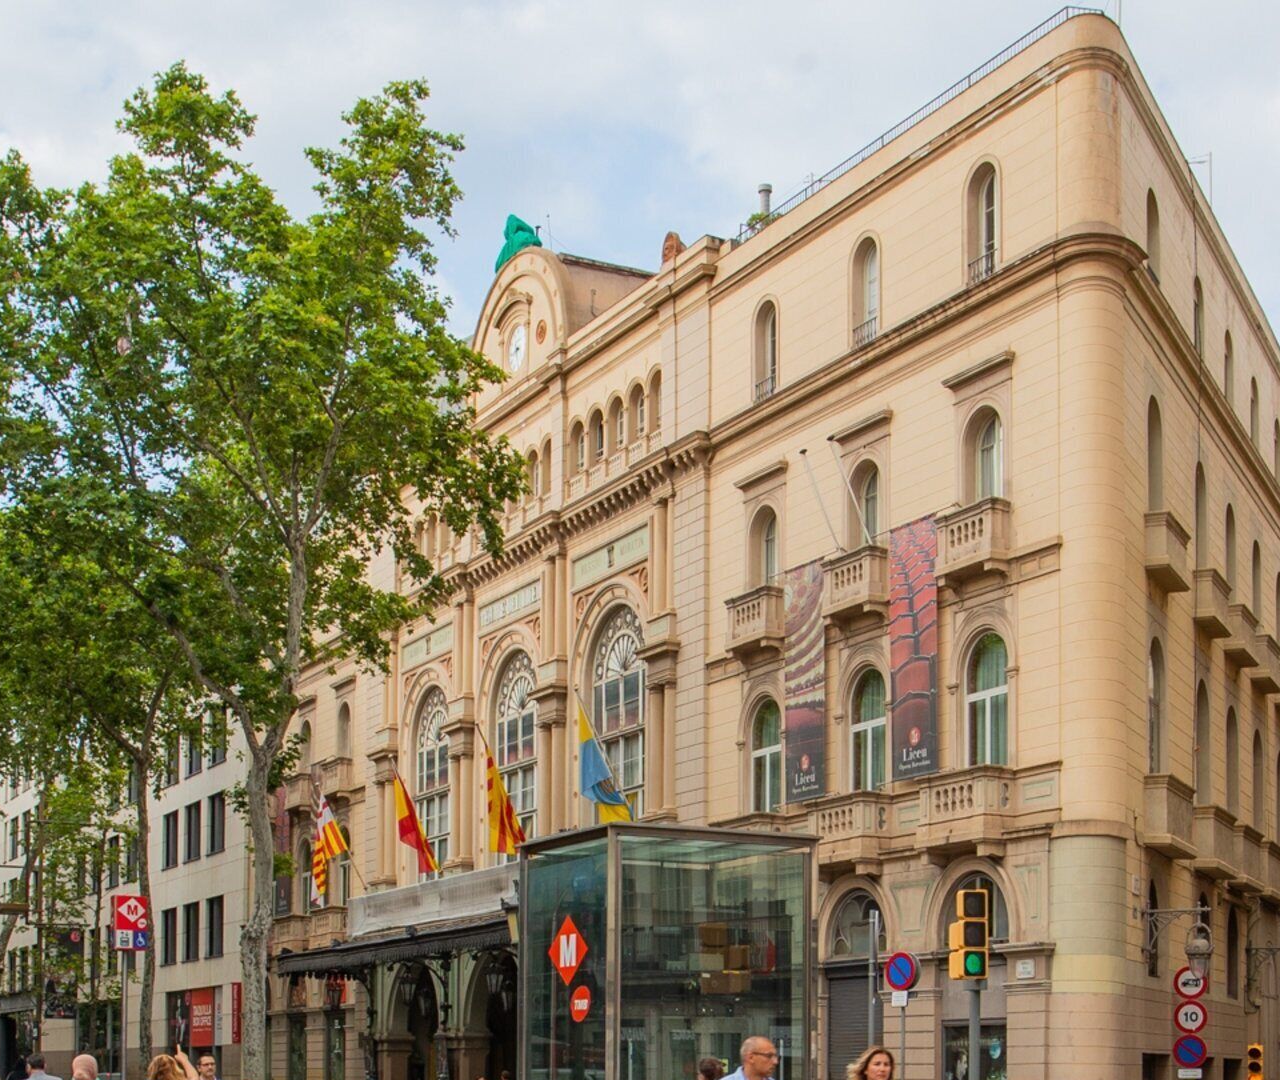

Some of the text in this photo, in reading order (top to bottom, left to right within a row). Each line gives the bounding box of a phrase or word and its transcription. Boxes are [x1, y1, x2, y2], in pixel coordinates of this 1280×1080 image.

[903, 747, 928, 761] Liceu
[127, 904, 138, 916] M
[560, 933, 577, 968] M
[1183, 1011, 1199, 1022] 10
